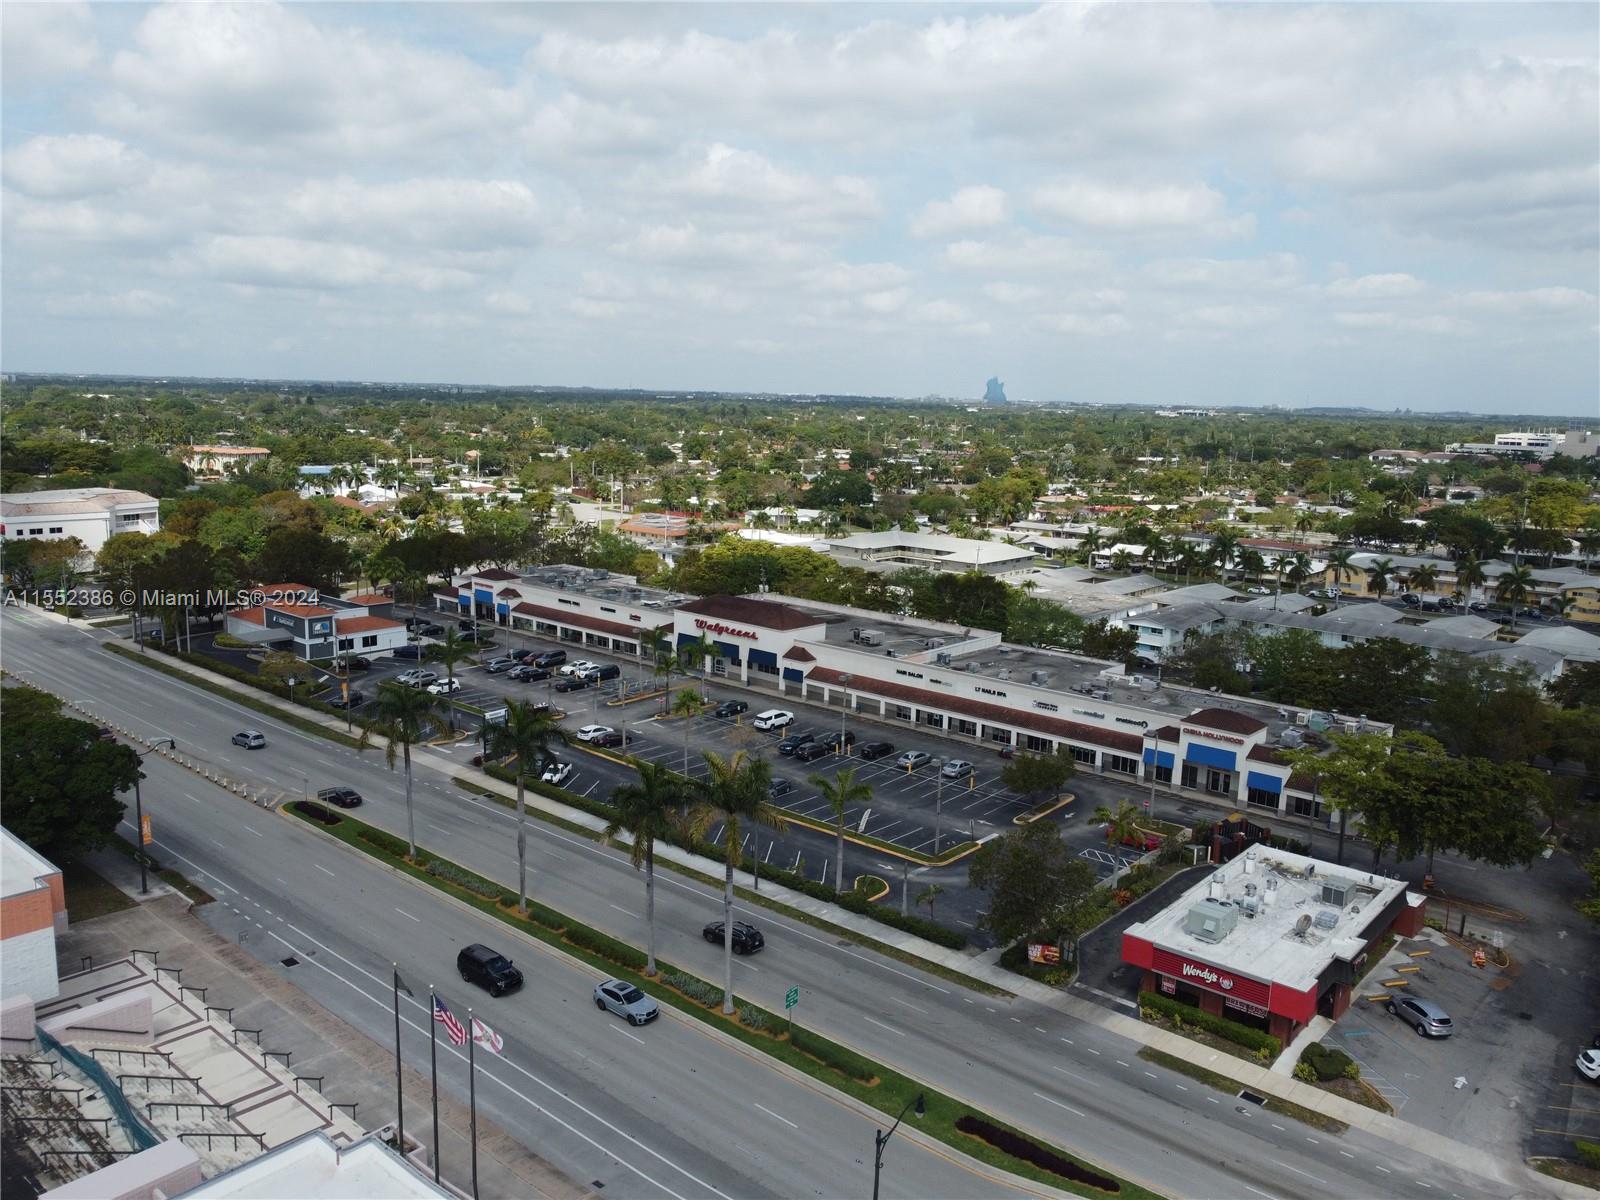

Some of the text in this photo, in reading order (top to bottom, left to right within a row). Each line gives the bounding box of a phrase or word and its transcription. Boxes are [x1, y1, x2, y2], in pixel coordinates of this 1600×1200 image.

[694, 618, 759, 640] Walgreens
[908, 671, 924, 679] SALON
[981, 687, 996, 696] NAILS
[1183, 727, 1245, 745] CHINA HOLLYWOOD
[1183, 963, 1218, 983] Wendy's
